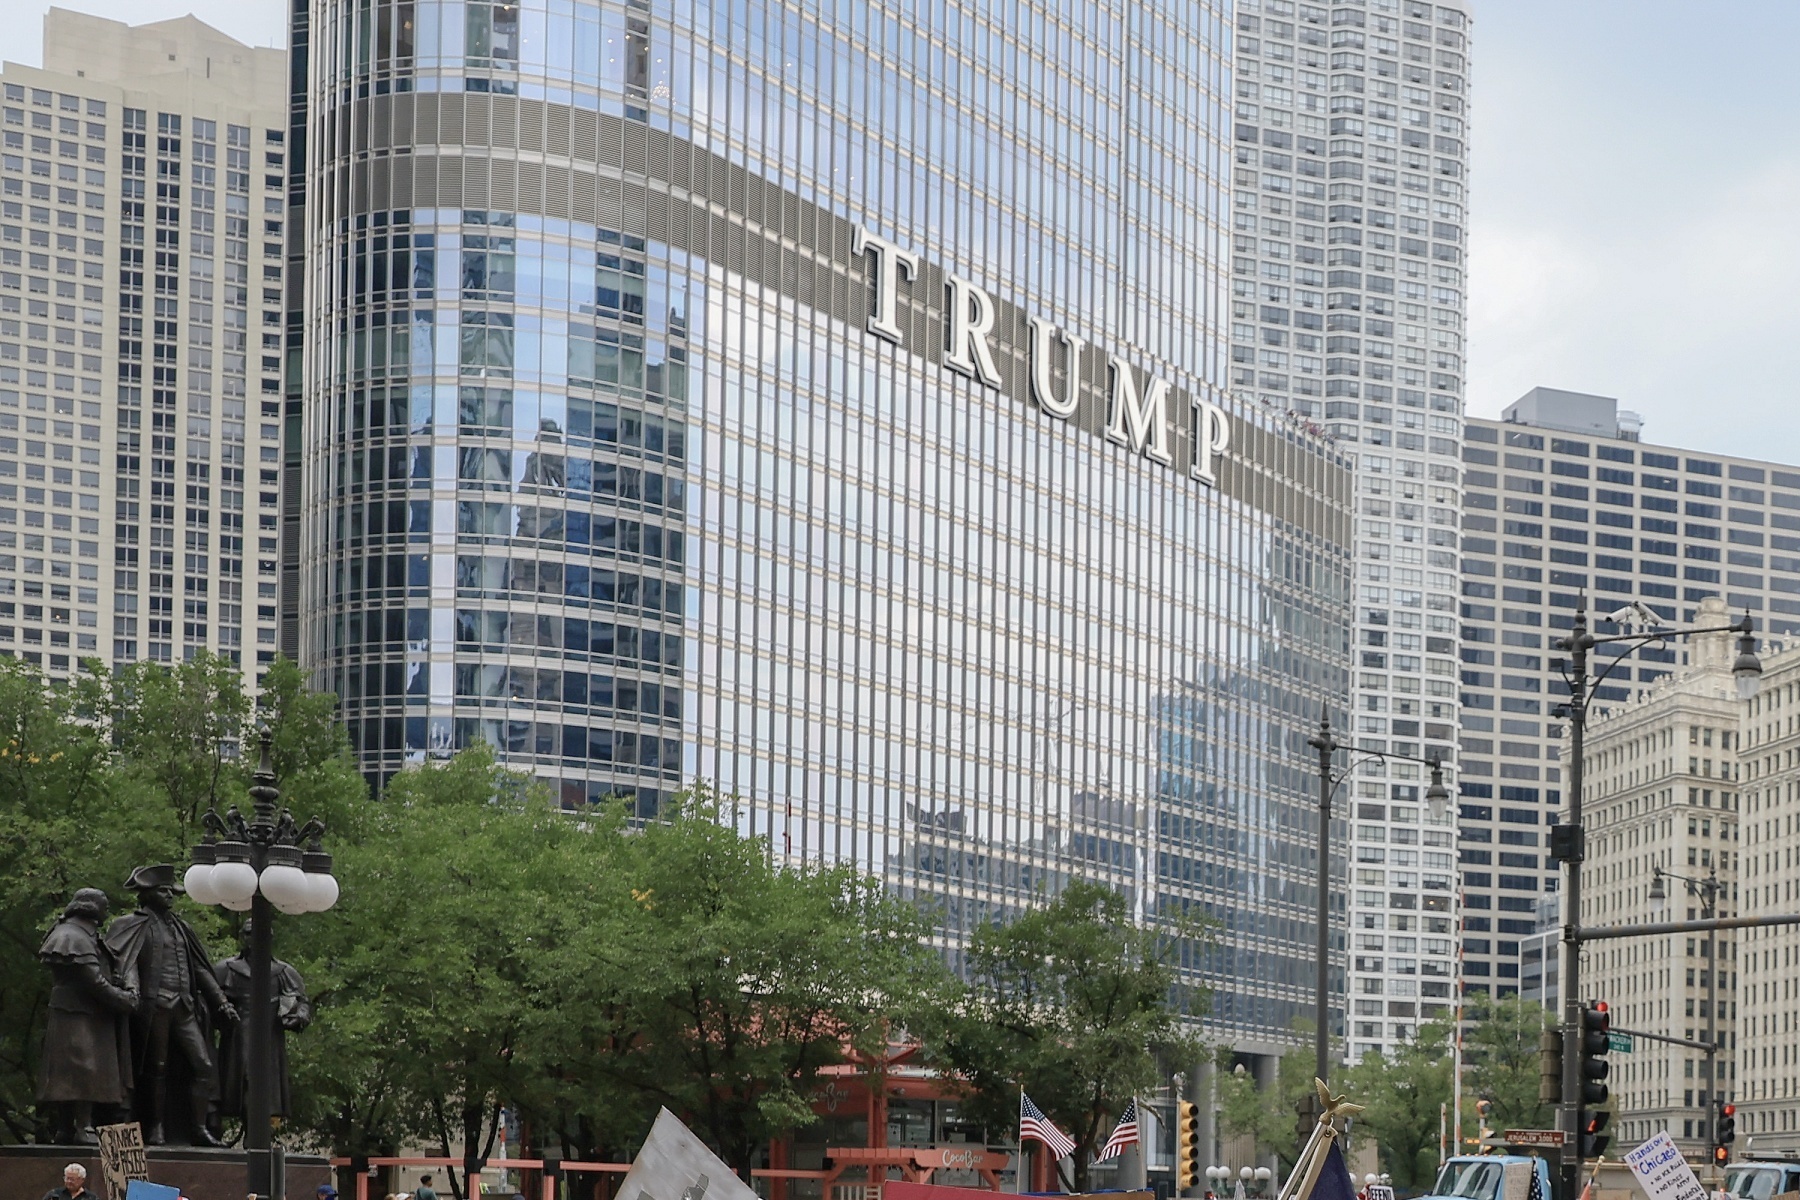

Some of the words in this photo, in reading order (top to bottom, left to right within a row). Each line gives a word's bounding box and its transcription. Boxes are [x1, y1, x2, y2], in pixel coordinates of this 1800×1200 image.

[852, 224, 1229, 487] TRUMP
[115, 1128, 139, 1148] MAKE
[1507, 1134, 1537, 1142] JERUSALEM
[942, 1149, 983, 1168] CocoBar
[1629, 1143, 1654, 1163] Hands
[1660, 1184, 1668, 1192] NO
